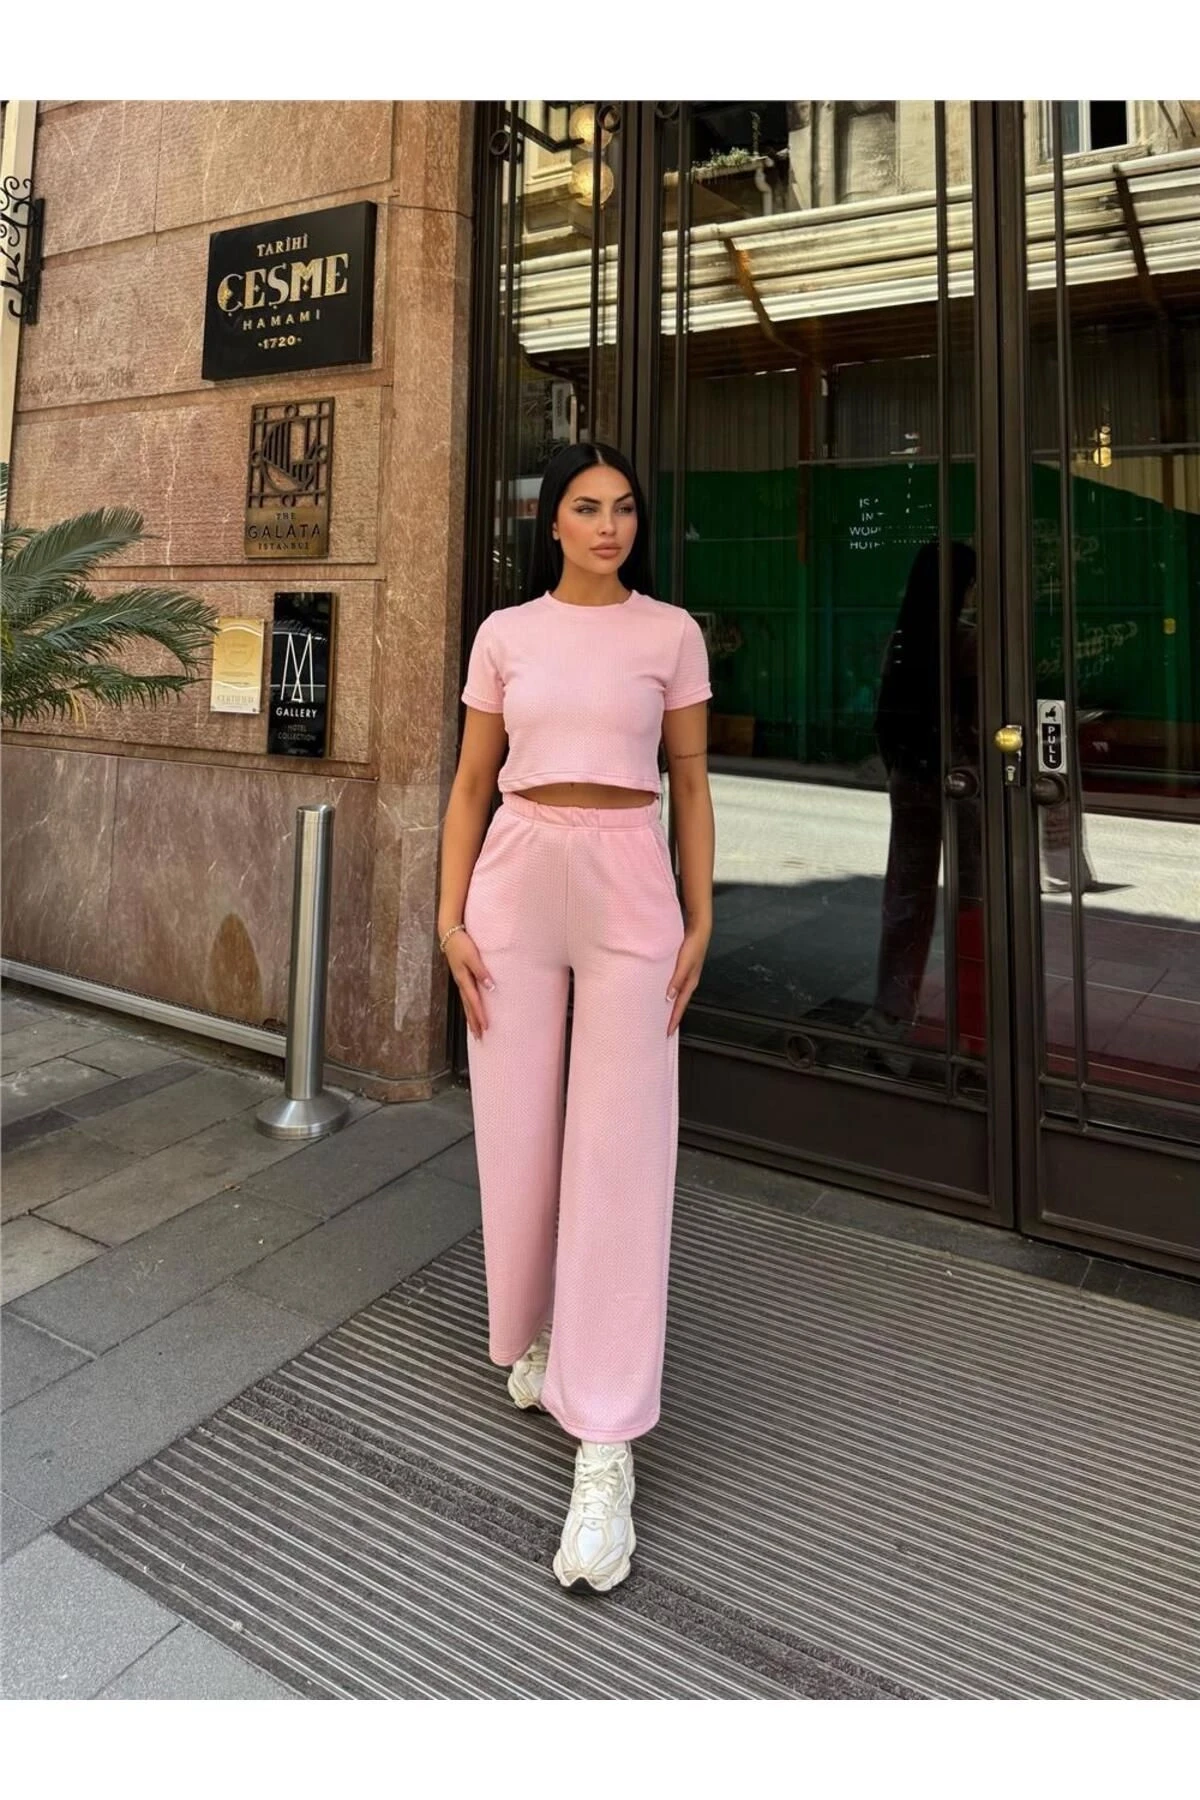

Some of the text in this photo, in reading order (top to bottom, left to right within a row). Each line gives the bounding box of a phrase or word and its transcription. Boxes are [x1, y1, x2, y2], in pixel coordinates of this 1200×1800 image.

[256, 233, 309, 257] TARİHİ
[216, 252, 349, 317] ÇEŞME
[242, 308, 321, 331] HAMAMI
[275, 512, 297, 521] THE
[247, 523, 321, 540] GALATA
[275, 707, 318, 719] GALLERY
[1047, 726, 1057, 764] PULL
